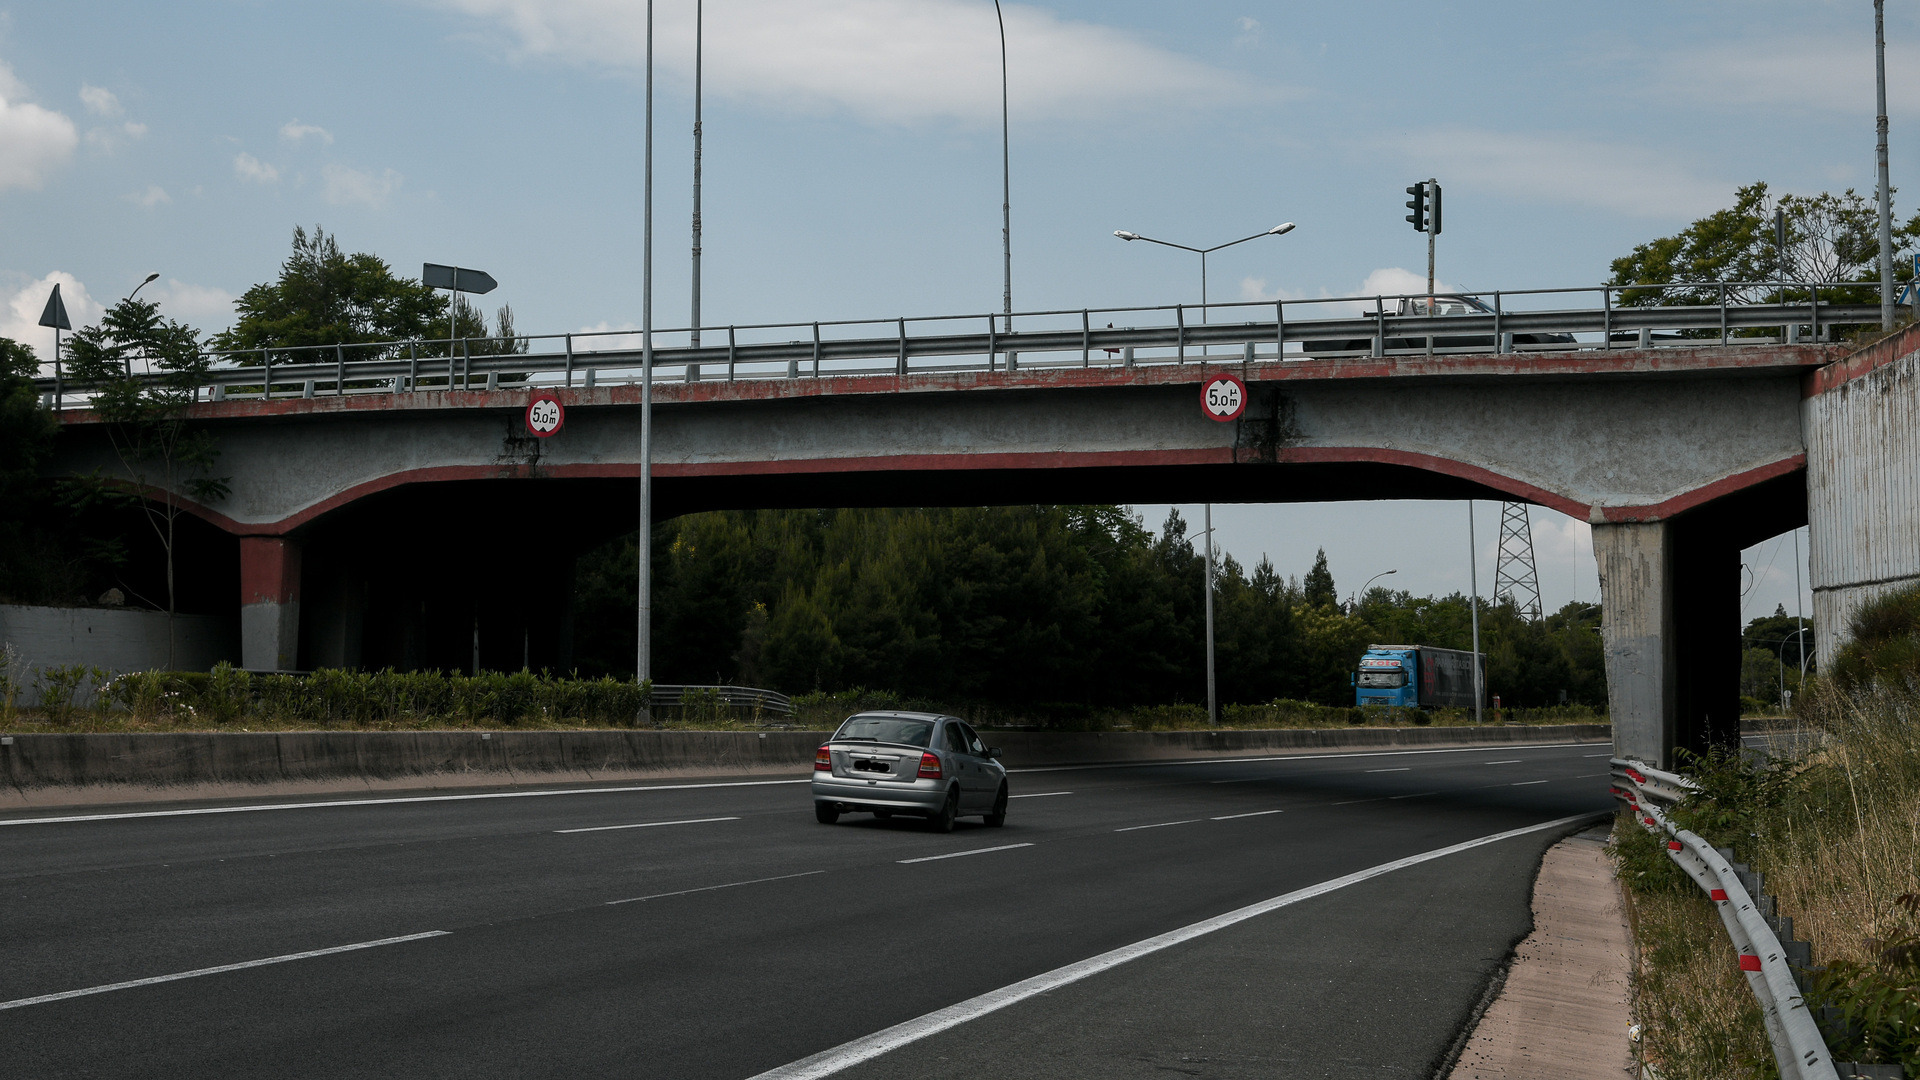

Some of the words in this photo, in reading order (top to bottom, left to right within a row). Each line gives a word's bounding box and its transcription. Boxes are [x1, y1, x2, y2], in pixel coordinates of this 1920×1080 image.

[1209, 388, 1228, 406] 5.0
[1229, 398, 1237, 406] m
[532, 406, 549, 423] 5.0
[549, 416, 556, 424] m
